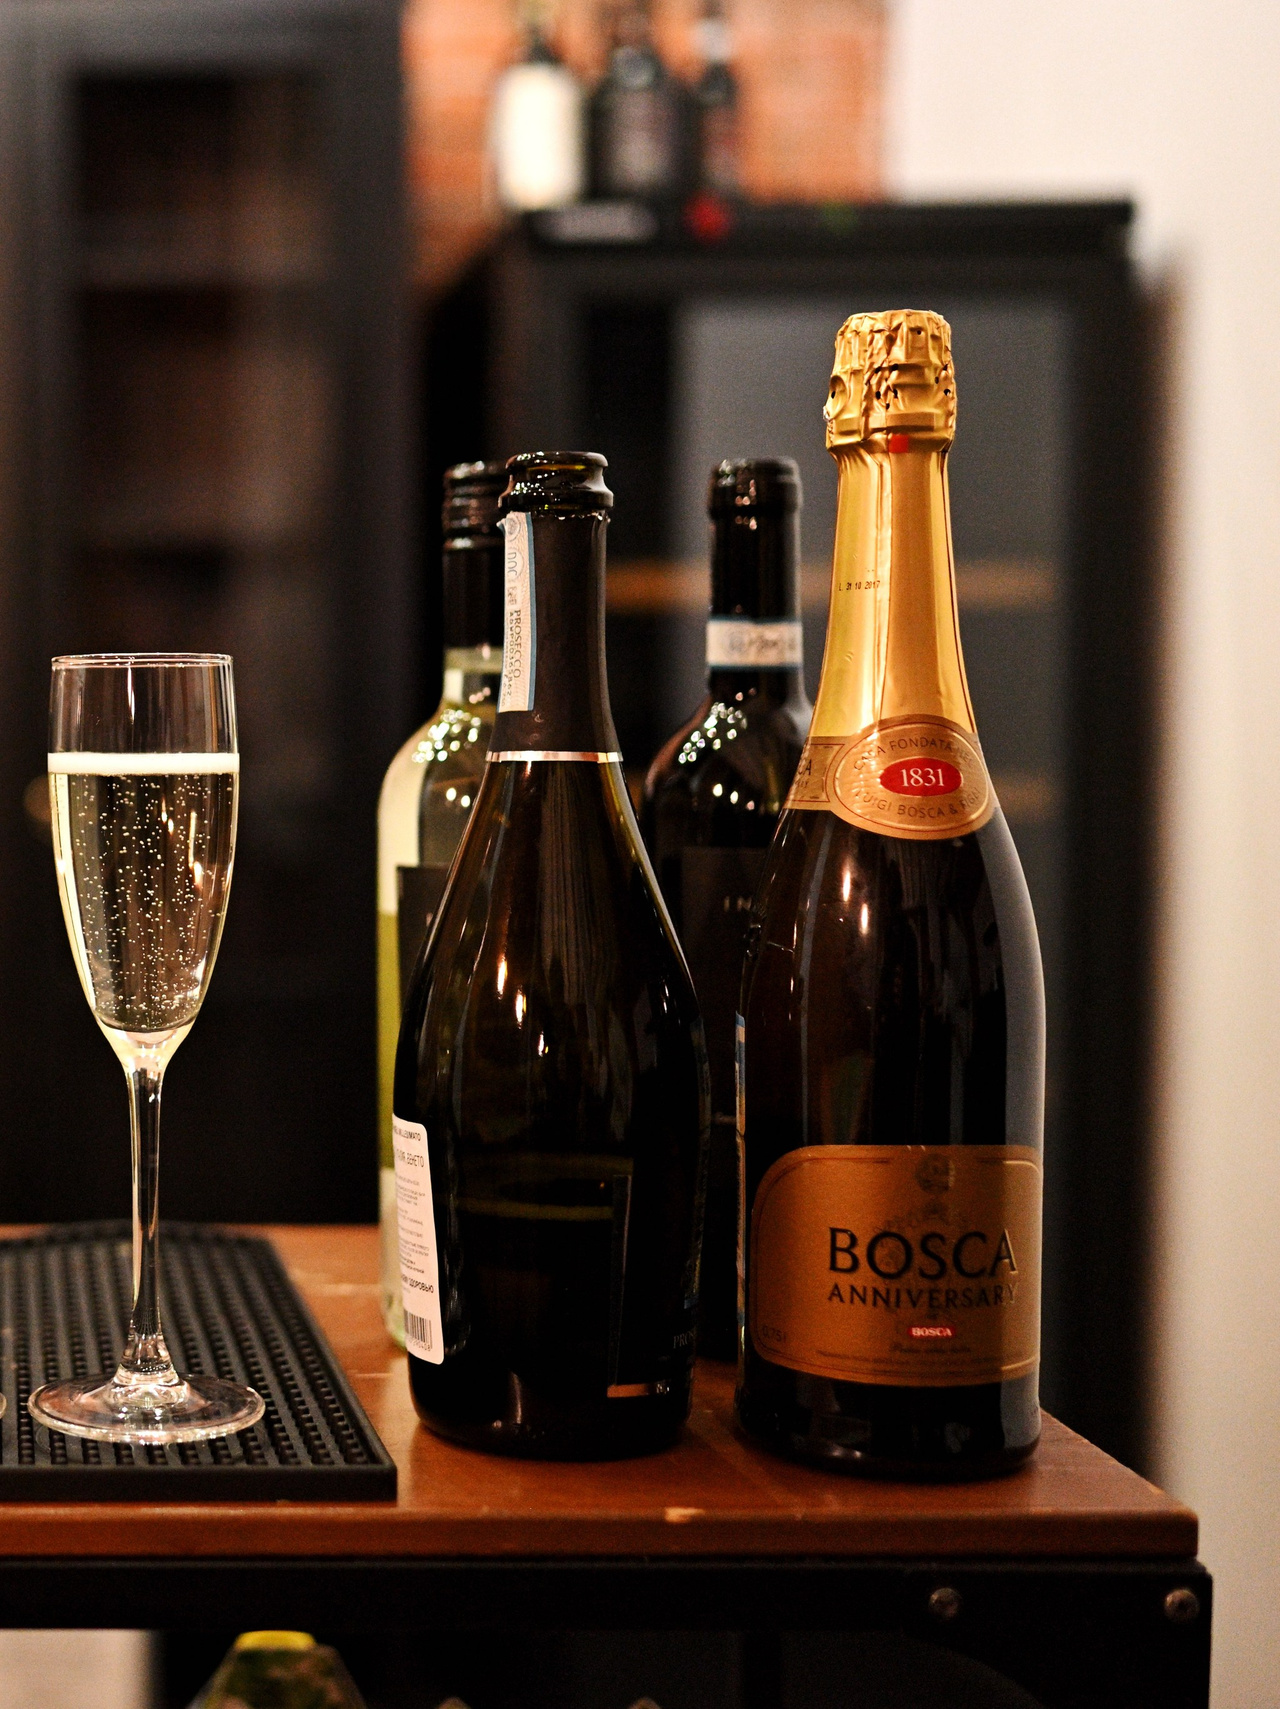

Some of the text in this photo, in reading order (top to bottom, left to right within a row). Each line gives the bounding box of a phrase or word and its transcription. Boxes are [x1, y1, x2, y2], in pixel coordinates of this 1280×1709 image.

[865, 580, 881, 590] 2017
[513, 609, 523, 678] PROSECCO
[889, 737, 952, 752] FONDATA
[900, 768, 945, 787] 1831
[897, 804, 945, 819] BOSCA
[948, 803, 958, 815] &
[829, 1227, 1019, 1280] BOSCA
[827, 1282, 1020, 1309] ANNIVERSARY
[910, 1326, 953, 1337] BOSCA
